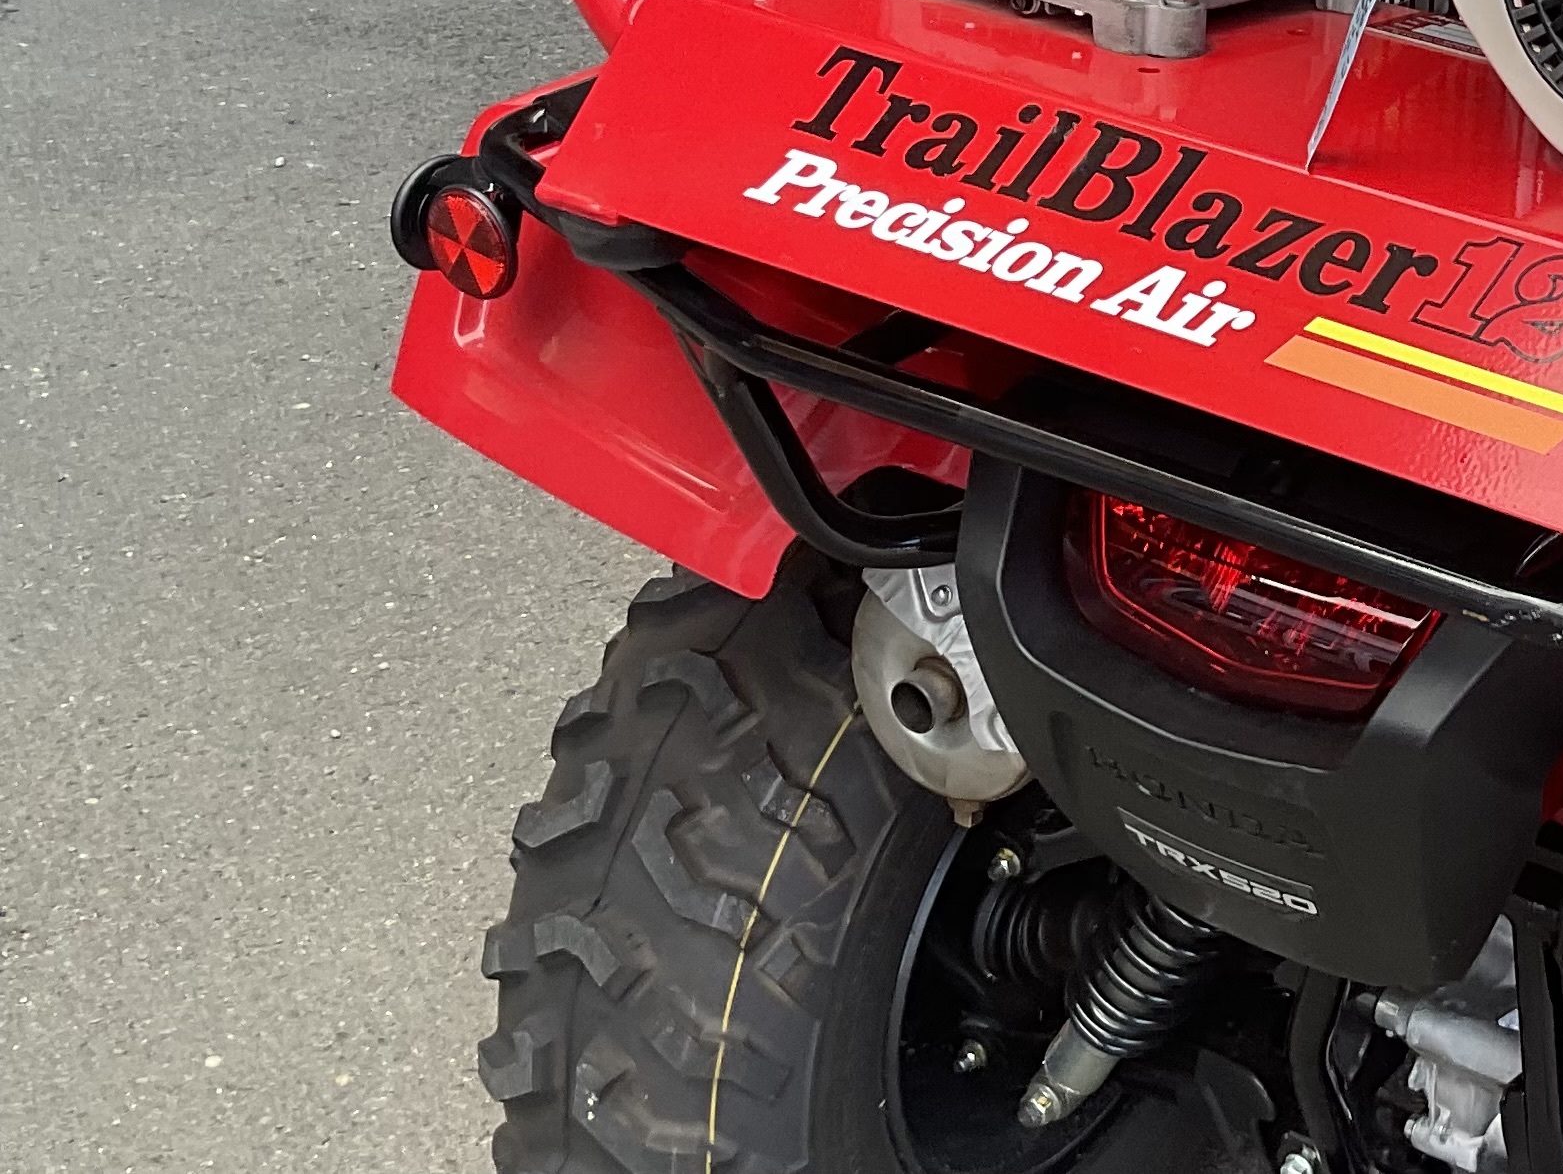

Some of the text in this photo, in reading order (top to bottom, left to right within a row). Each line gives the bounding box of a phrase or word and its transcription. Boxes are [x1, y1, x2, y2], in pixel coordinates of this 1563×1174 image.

[743, 150, 1258, 348] Precision Air
[790, 47, 1441, 315] TrailBlazer
[1124, 823, 1318, 915] TRX520
